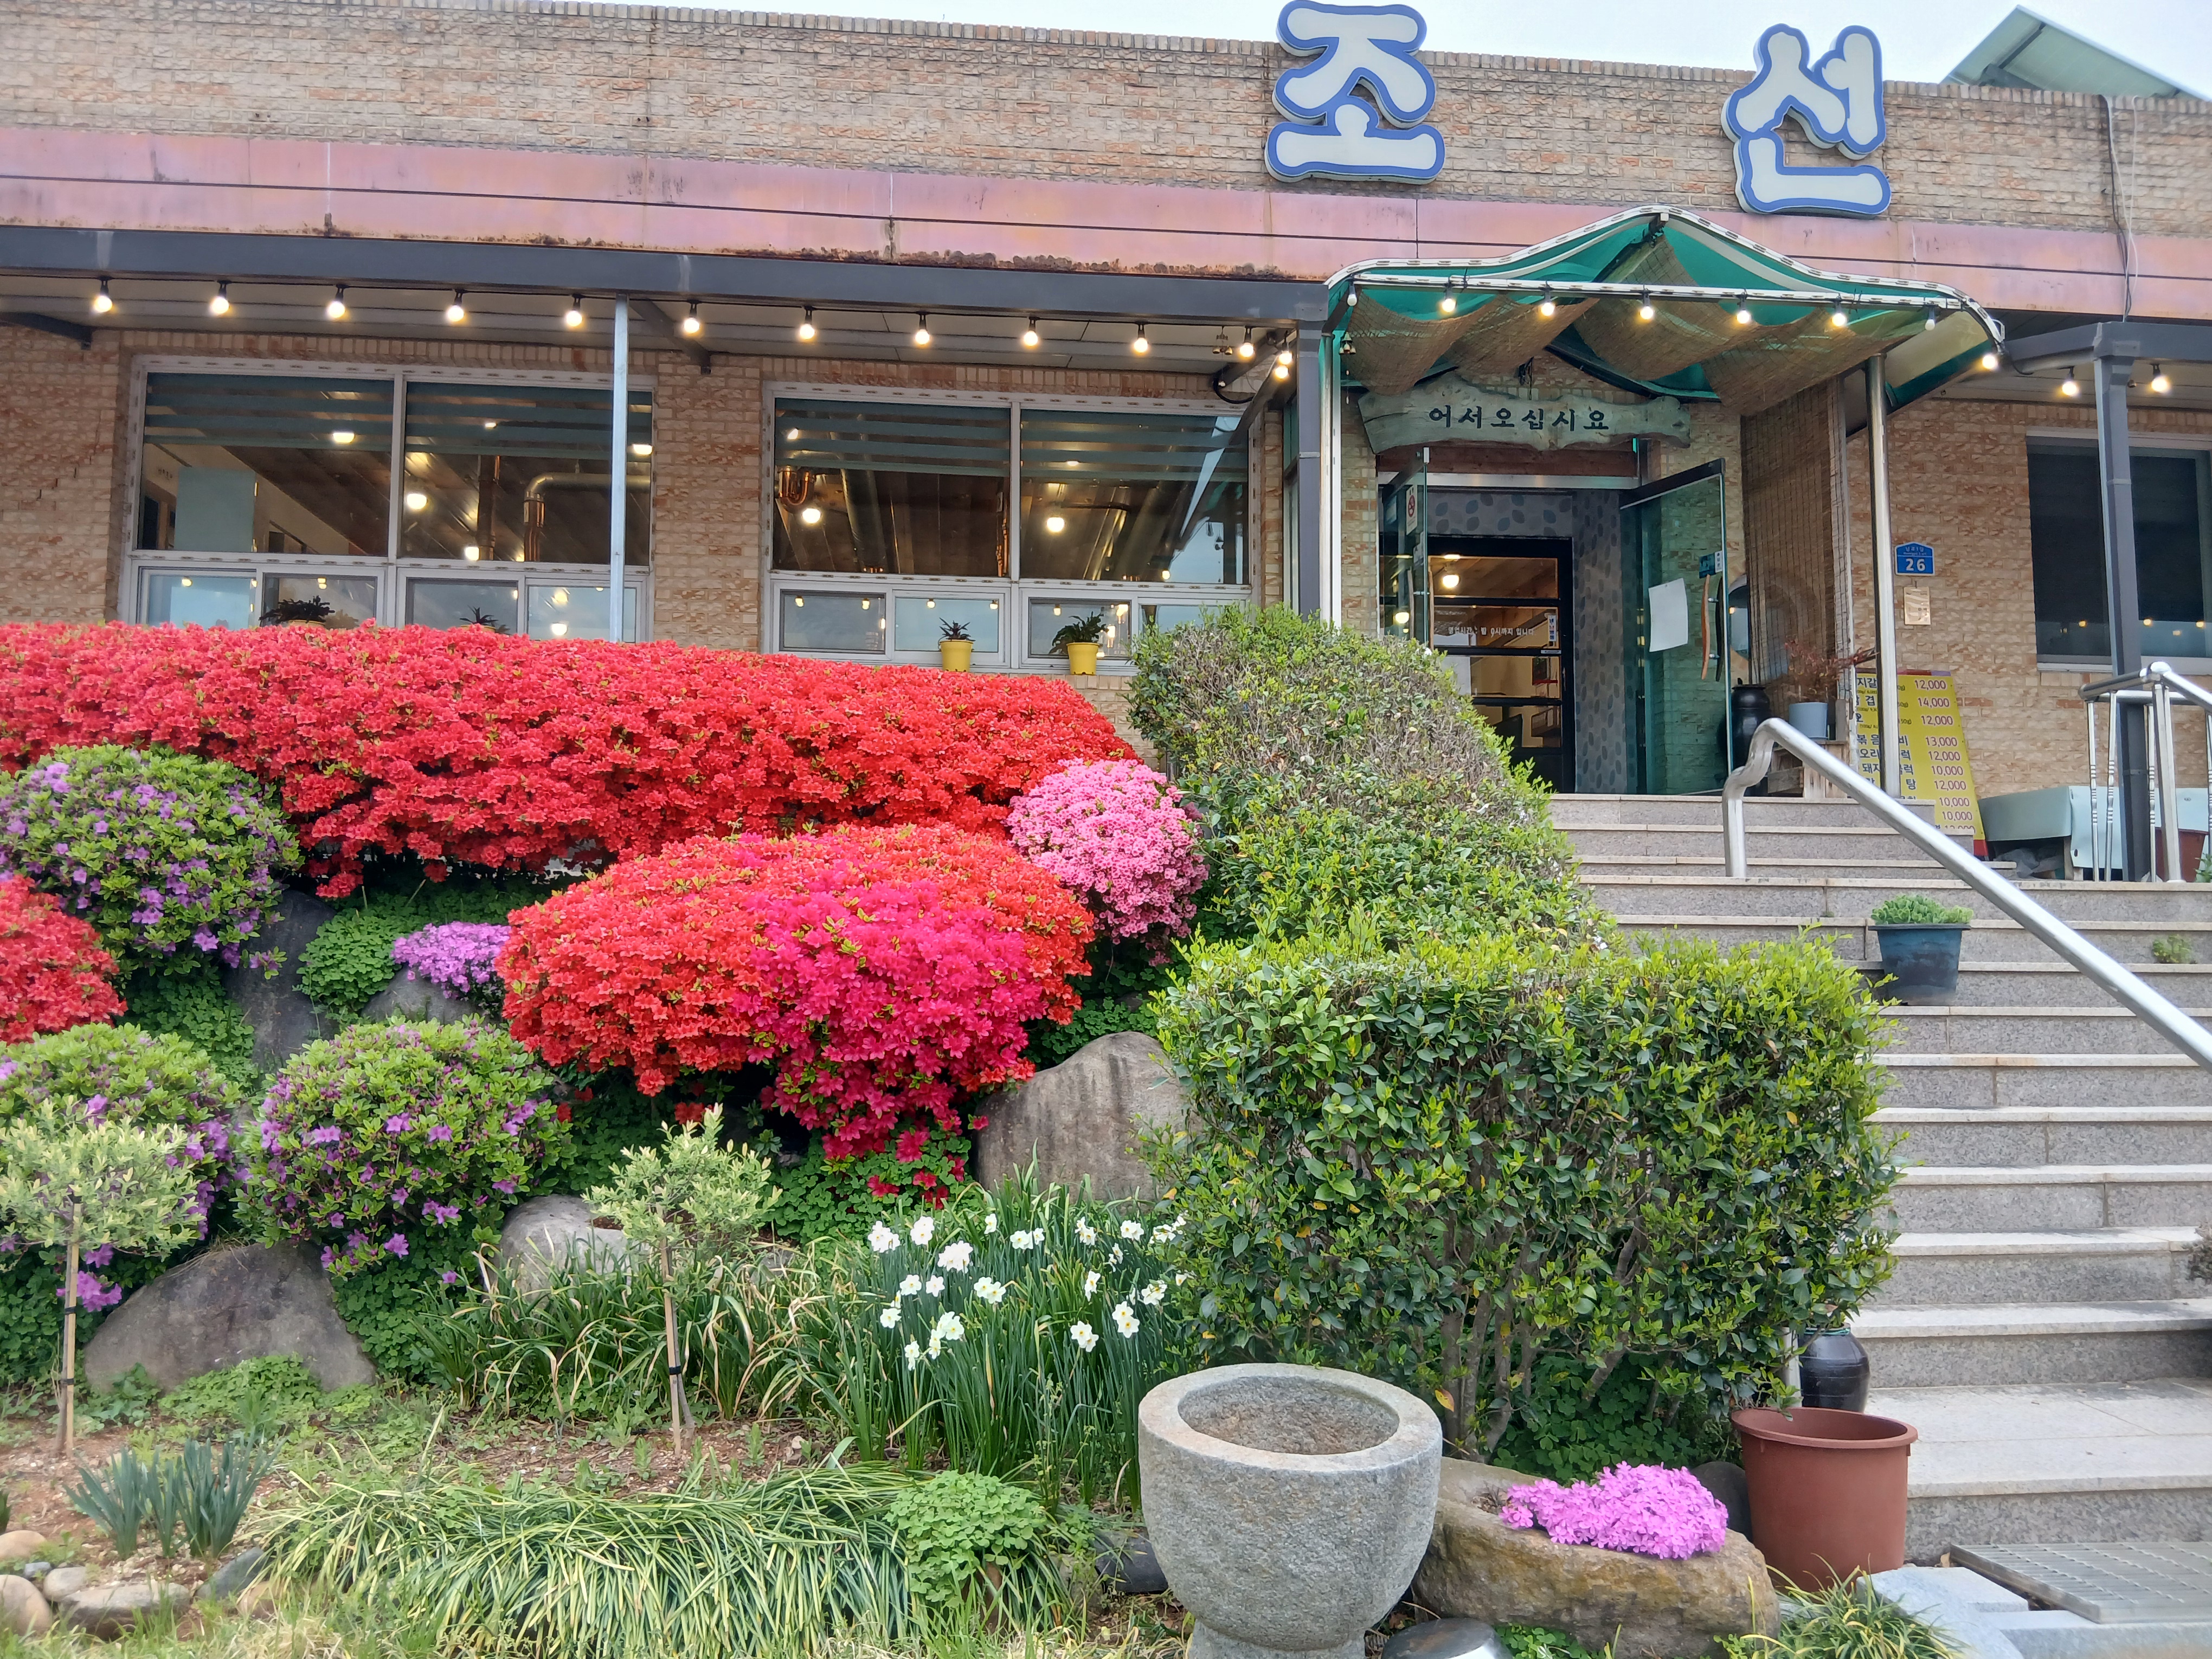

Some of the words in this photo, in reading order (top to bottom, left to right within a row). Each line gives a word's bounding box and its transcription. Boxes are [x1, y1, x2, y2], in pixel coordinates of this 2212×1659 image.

[1906, 558, 1926, 571] 26
[1914, 679, 1946, 691] 12,000
[1918, 697, 1950, 708] 14,000
[1921, 715, 1953, 726] 12,000
[1925, 736, 1957, 747] 13,000
[1928, 751, 1960, 762] 12,000
[1931, 766, 1963, 776] 10,000
[1934, 780, 1966, 791] 12,000
[1939, 797, 1970, 807] 10,000
[1942, 811, 1972, 821] 10,000
